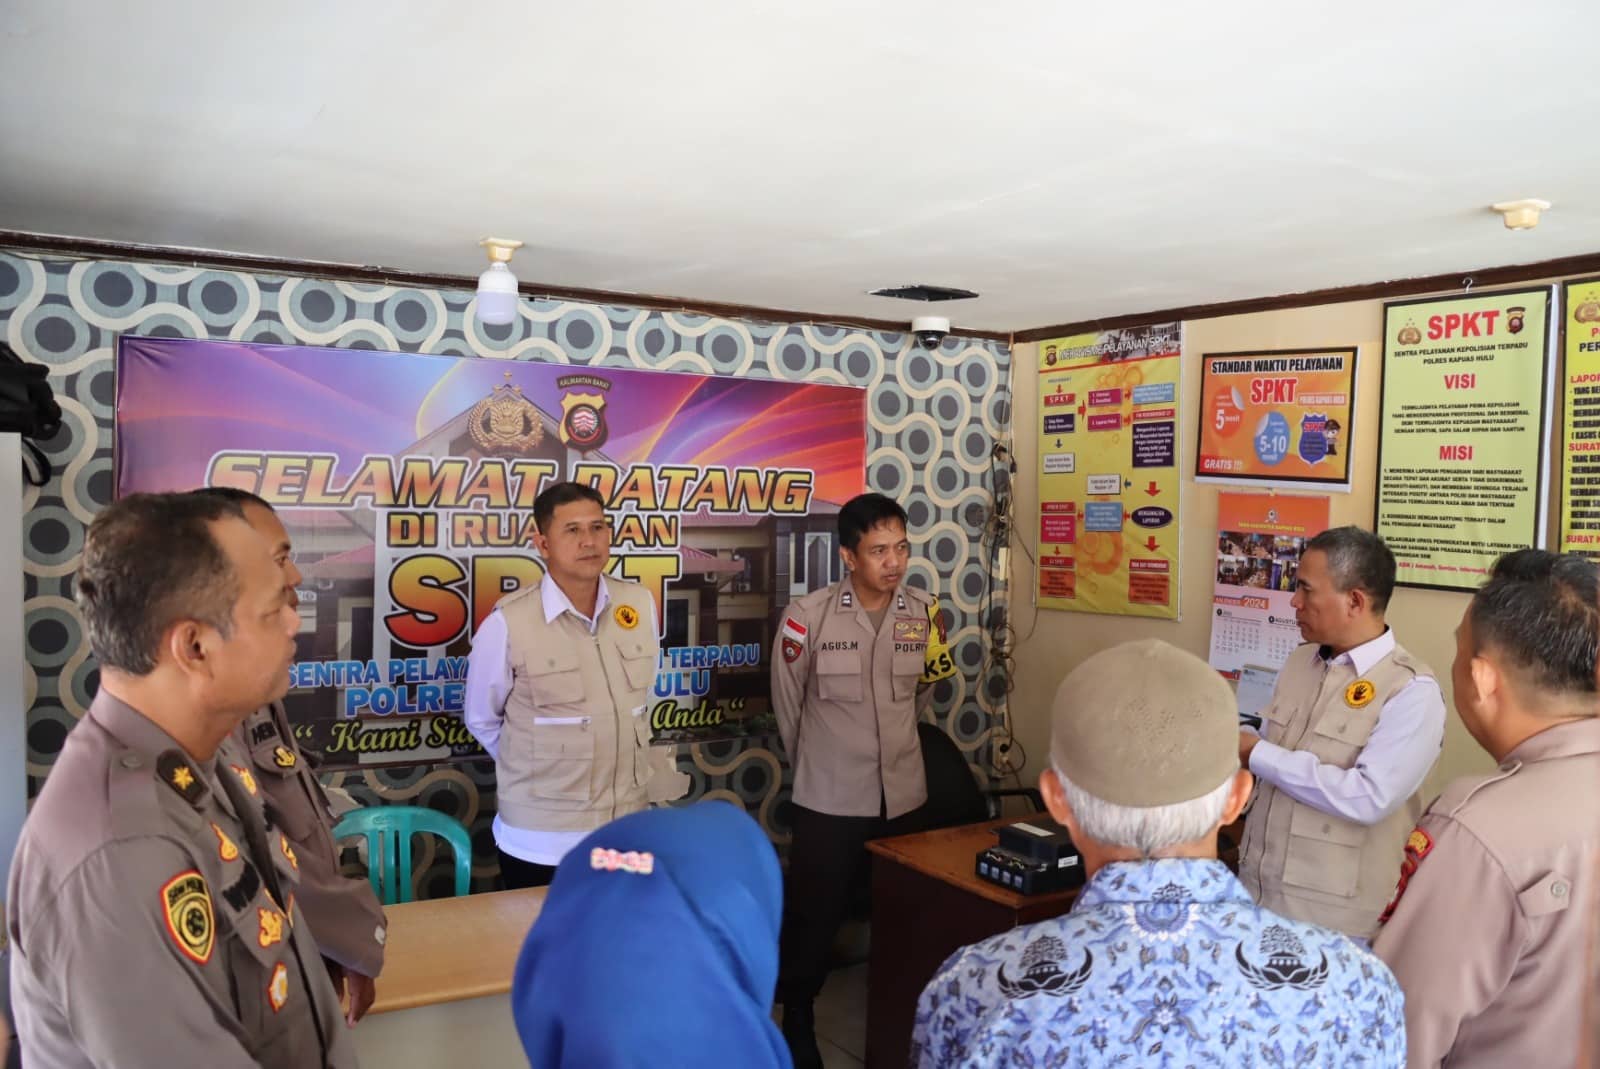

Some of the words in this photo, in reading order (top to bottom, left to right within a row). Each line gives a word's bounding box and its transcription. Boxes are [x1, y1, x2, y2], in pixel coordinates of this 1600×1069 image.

[1427, 310, 1500, 340] SPKT
[1103, 339, 1148, 354] PELAYANAN
[1149, 334, 1171, 348] SPKT
[1419, 347, 1455, 356] PELAYANAN
[1457, 345, 1496, 353] KEPOLISIAN
[1498, 342, 1528, 350] TERPADU
[1212, 361, 1252, 373] STANDAR
[1254, 359, 1287, 372] WAKTU
[1289, 357, 1343, 371] PELAYANAN
[559, 376, 592, 386] KALIMANTAN
[592, 377, 610, 389] BARAT
[1251, 378, 1297, 404] SPKT
[1444, 373, 1476, 390] VISI
[1215, 409, 1225, 430] 5
[1259, 435, 1287, 453] 5-10
[1439, 445, 1473, 460] MISI
[1204, 458, 1233, 470] GRATIS
[206, 451, 556, 510] SELAMAT
[387, 512, 438, 548] DI
[453, 513, 679, 547] RUAAN
[384, 553, 680, 647] SPT
[1244, 597, 1266, 610] 2024
[1275, 617, 1296, 625] AGUSTU
[821, 641, 859, 651] AGUS.M
[667, 643, 761, 669] TERPADU
[345, 683, 467, 717] POLRE
[654, 670, 710, 698] ULU
[326, 718, 422, 753] Kami
[651, 699, 723, 730] Anda
